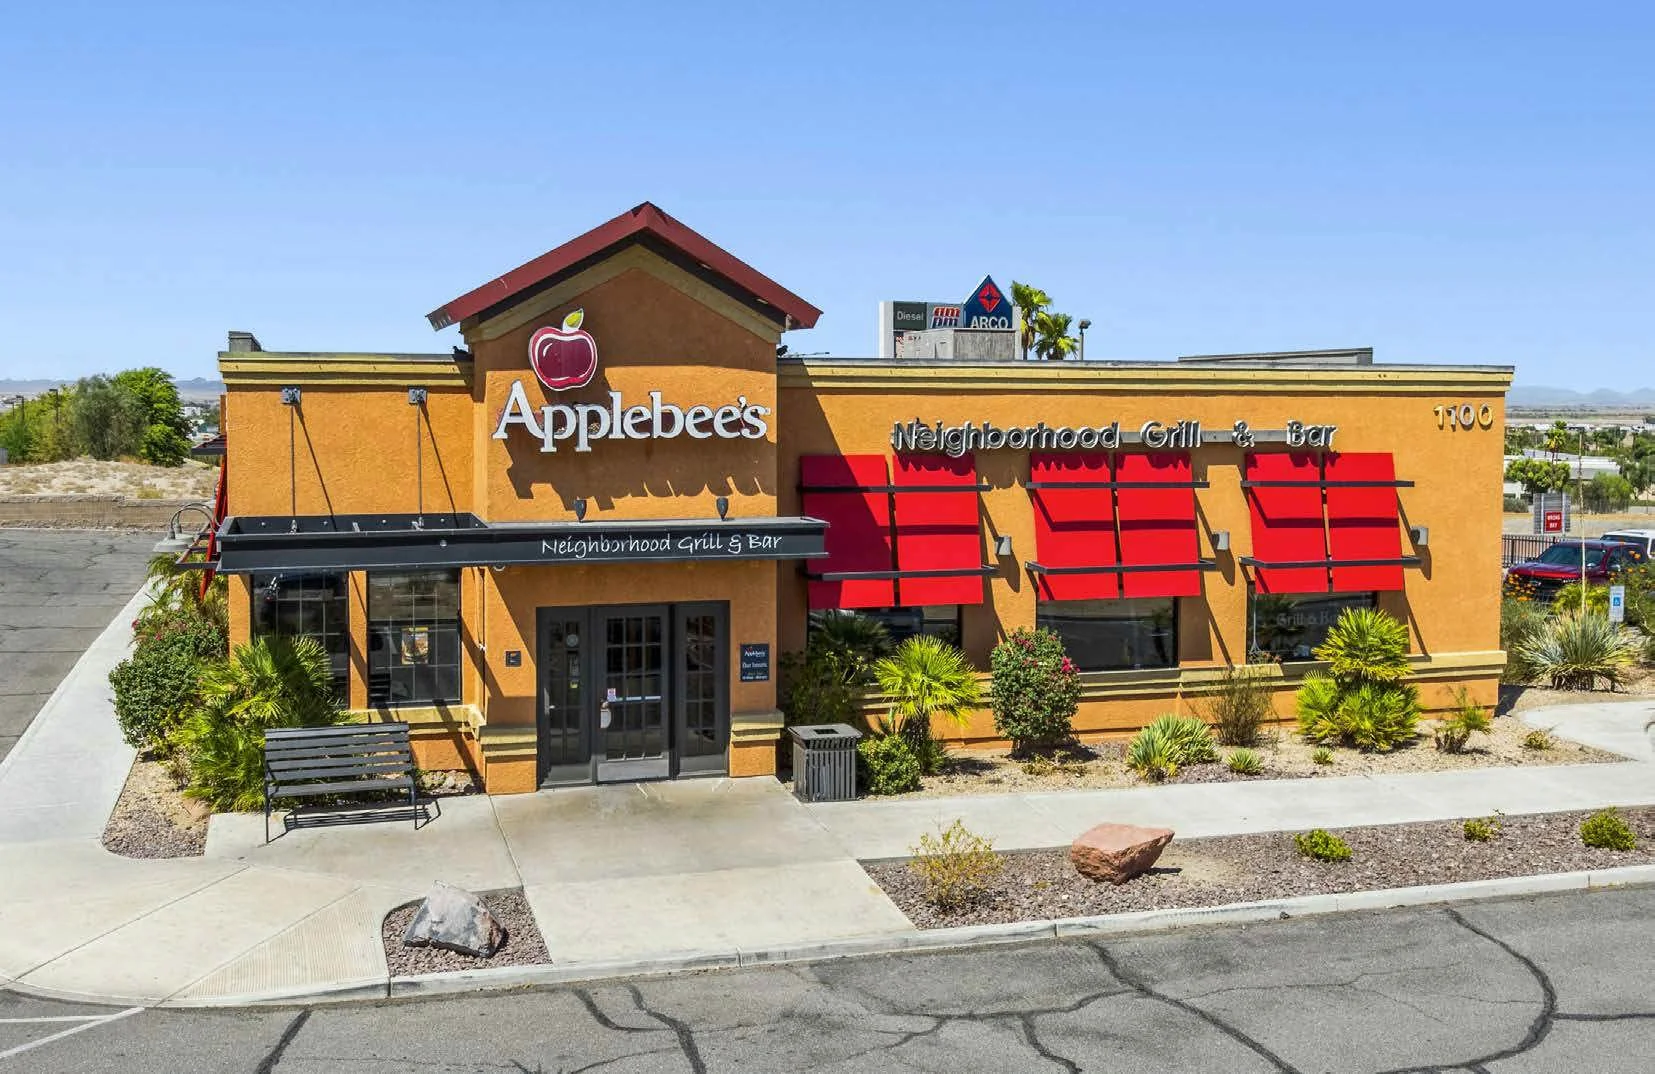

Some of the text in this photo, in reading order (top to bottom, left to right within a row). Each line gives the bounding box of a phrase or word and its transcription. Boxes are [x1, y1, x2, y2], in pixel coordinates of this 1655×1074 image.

[897, 311, 924, 321] Diesel
[970, 315, 1009, 329] ARCO
[492, 379, 771, 453] Applebee's
[1433, 404, 1493, 428] 1100
[891, 420, 1337, 458] Neighborhood Grill & Bar
[542, 533, 782, 558] Neighborhood Grill & Bar
